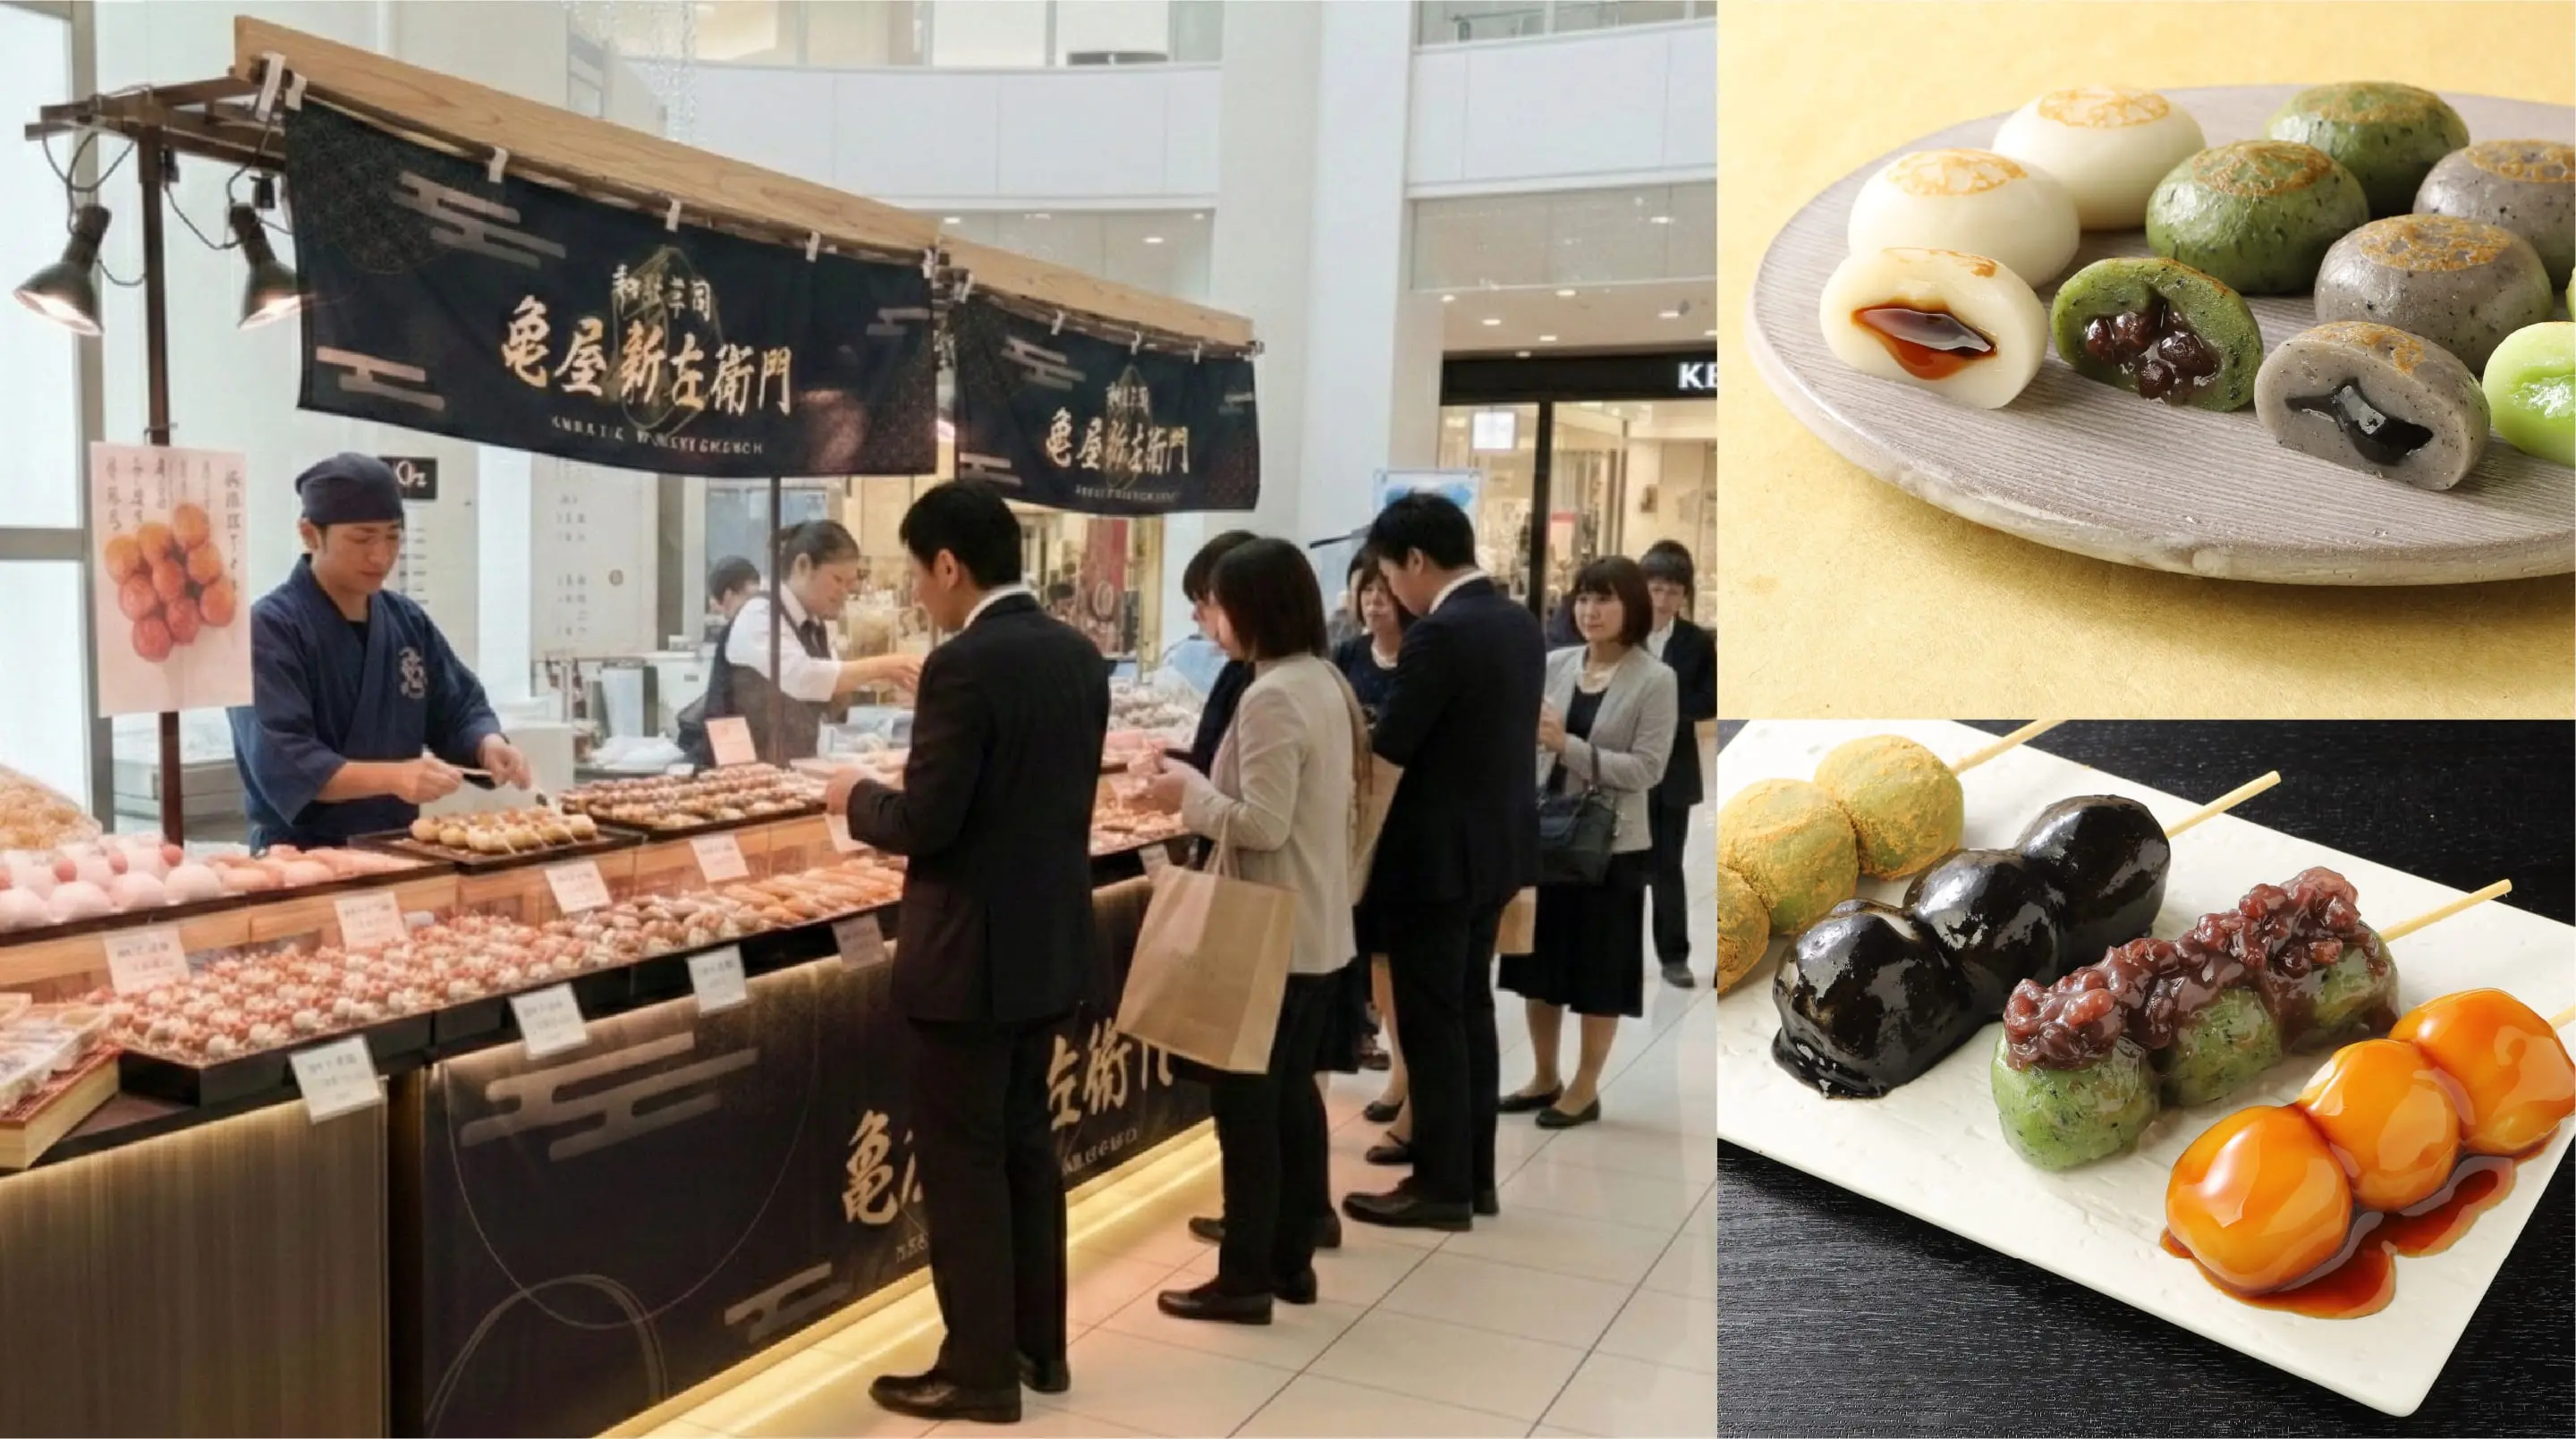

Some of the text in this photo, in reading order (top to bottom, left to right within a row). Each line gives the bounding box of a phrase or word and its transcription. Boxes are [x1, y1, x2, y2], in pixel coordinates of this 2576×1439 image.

[501, 294, 791, 416] 亀屋新左衛門
